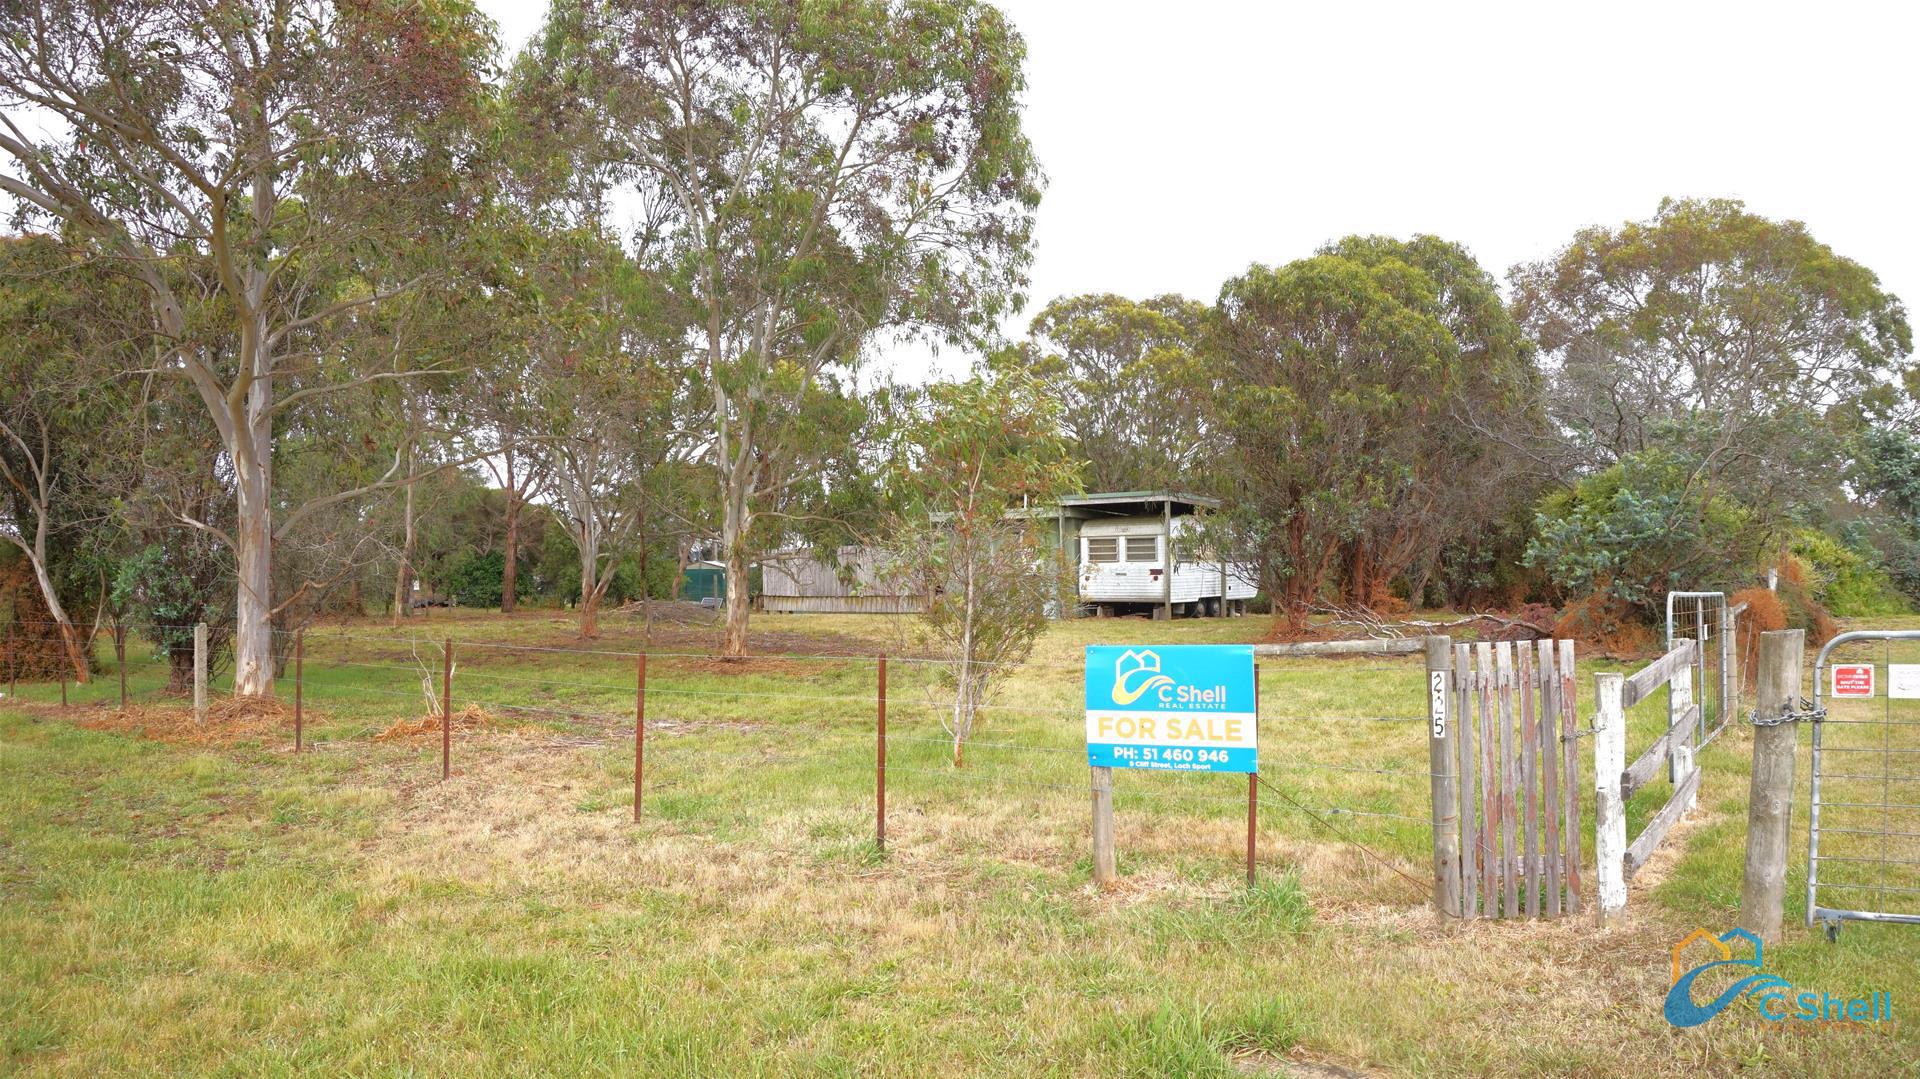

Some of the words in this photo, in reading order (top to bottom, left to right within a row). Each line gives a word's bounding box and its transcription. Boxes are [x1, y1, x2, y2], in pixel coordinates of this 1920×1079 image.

[1158, 685, 1173, 703] C
[1177, 685, 1226, 703] Shell
[1098, 717, 1157, 740] FOR
[1166, 718, 1243, 741] SALE
[1114, 746, 1139, 759] PH:
[1143, 748, 1158, 760] 51
[1162, 748, 1193, 762] 460
[1198, 750, 1229, 763] 946
